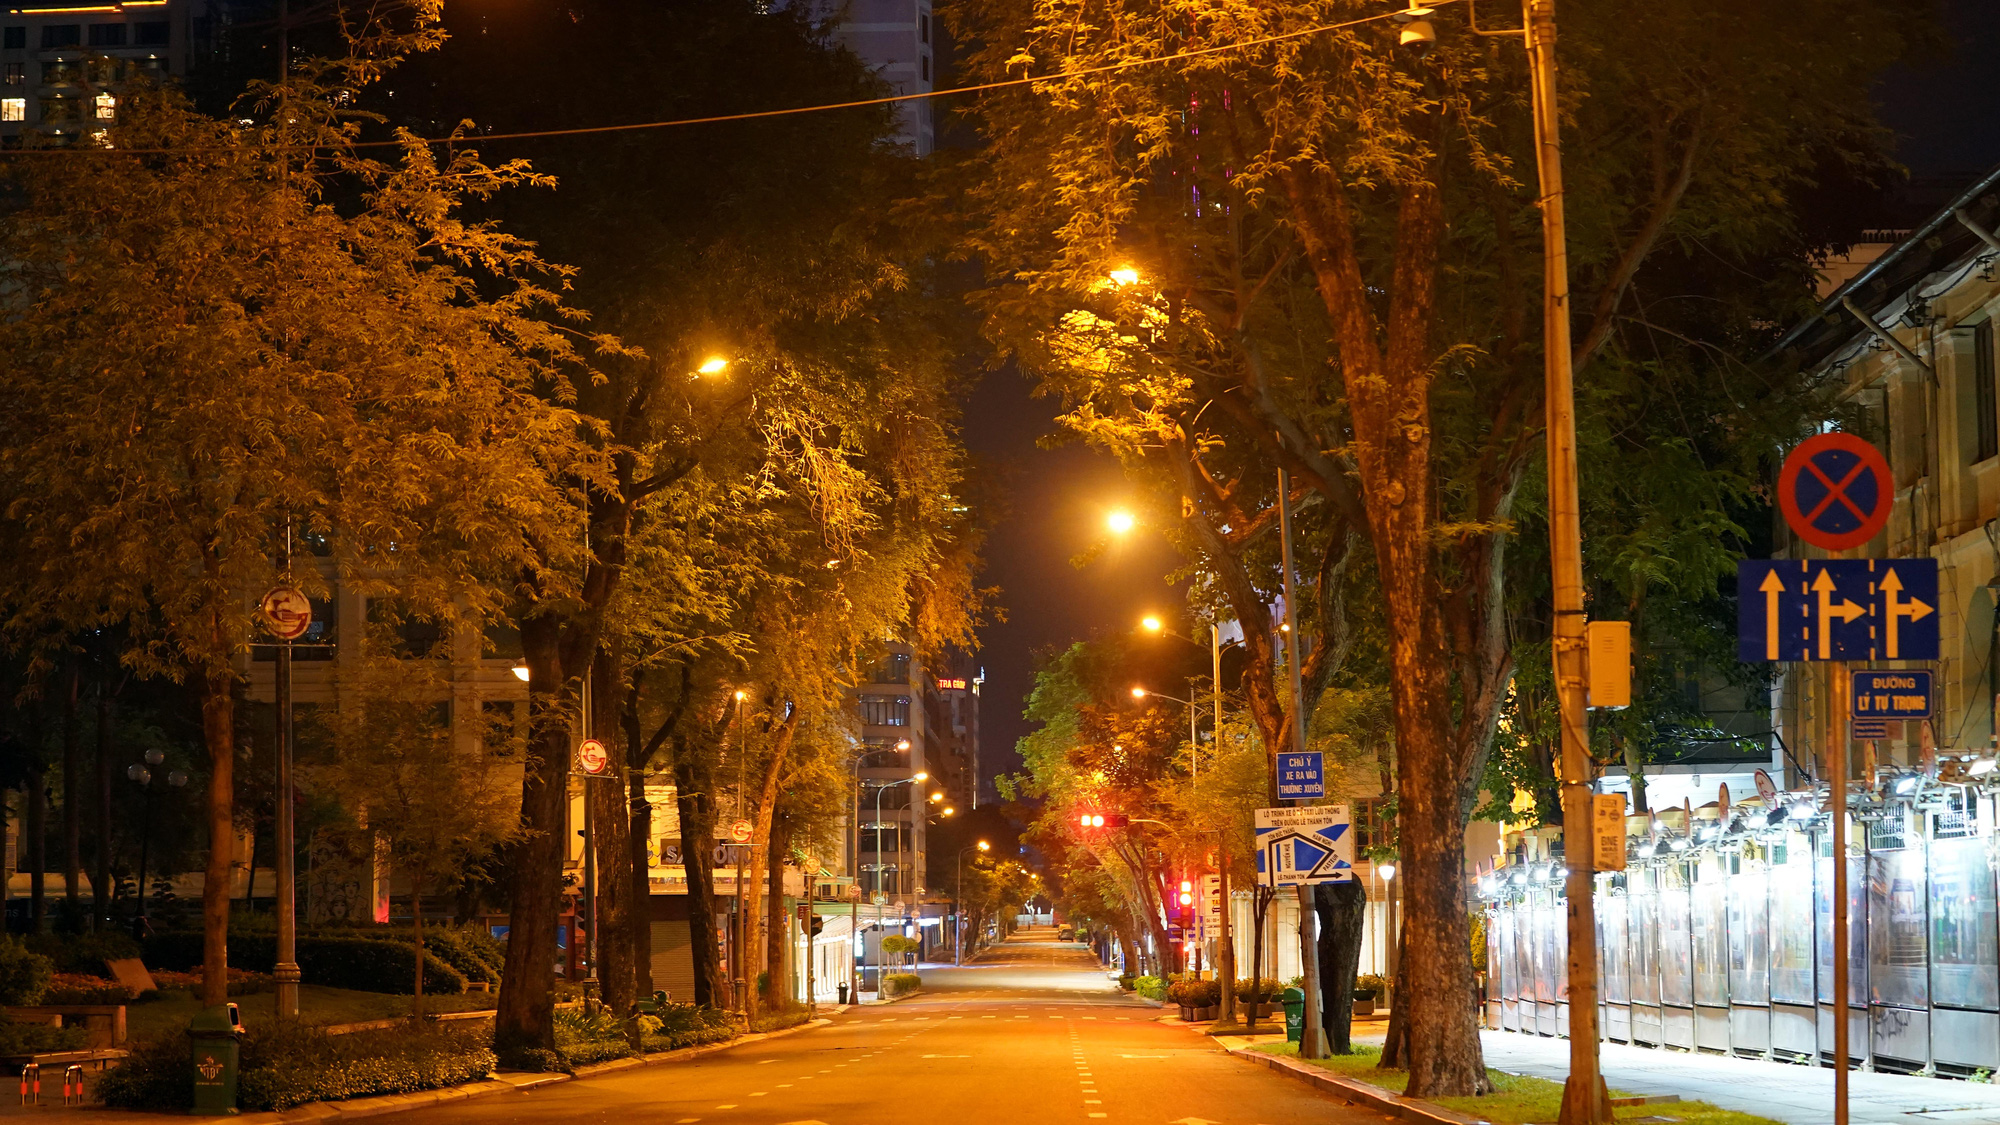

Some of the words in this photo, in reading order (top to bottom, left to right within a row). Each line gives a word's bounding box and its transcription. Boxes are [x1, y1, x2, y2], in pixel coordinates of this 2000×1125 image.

[1872, 675, 1915, 689] ĐƯỜNG
[1858, 691, 1871, 711] LÝ
[1874, 693, 1890, 713] TỰ
[1892, 695, 1926, 713] TRỌNG
[1289, 756, 1304, 767] CHÚ
[1306, 756, 1312, 767] Ý
[1286, 771, 1294, 780] XE
[1296, 771, 1305, 780] RA
[1306, 769, 1317, 779] VÀO
[1280, 782, 1303, 794] THƯỜNG
[1304, 781, 1323, 793] XUYÊN
